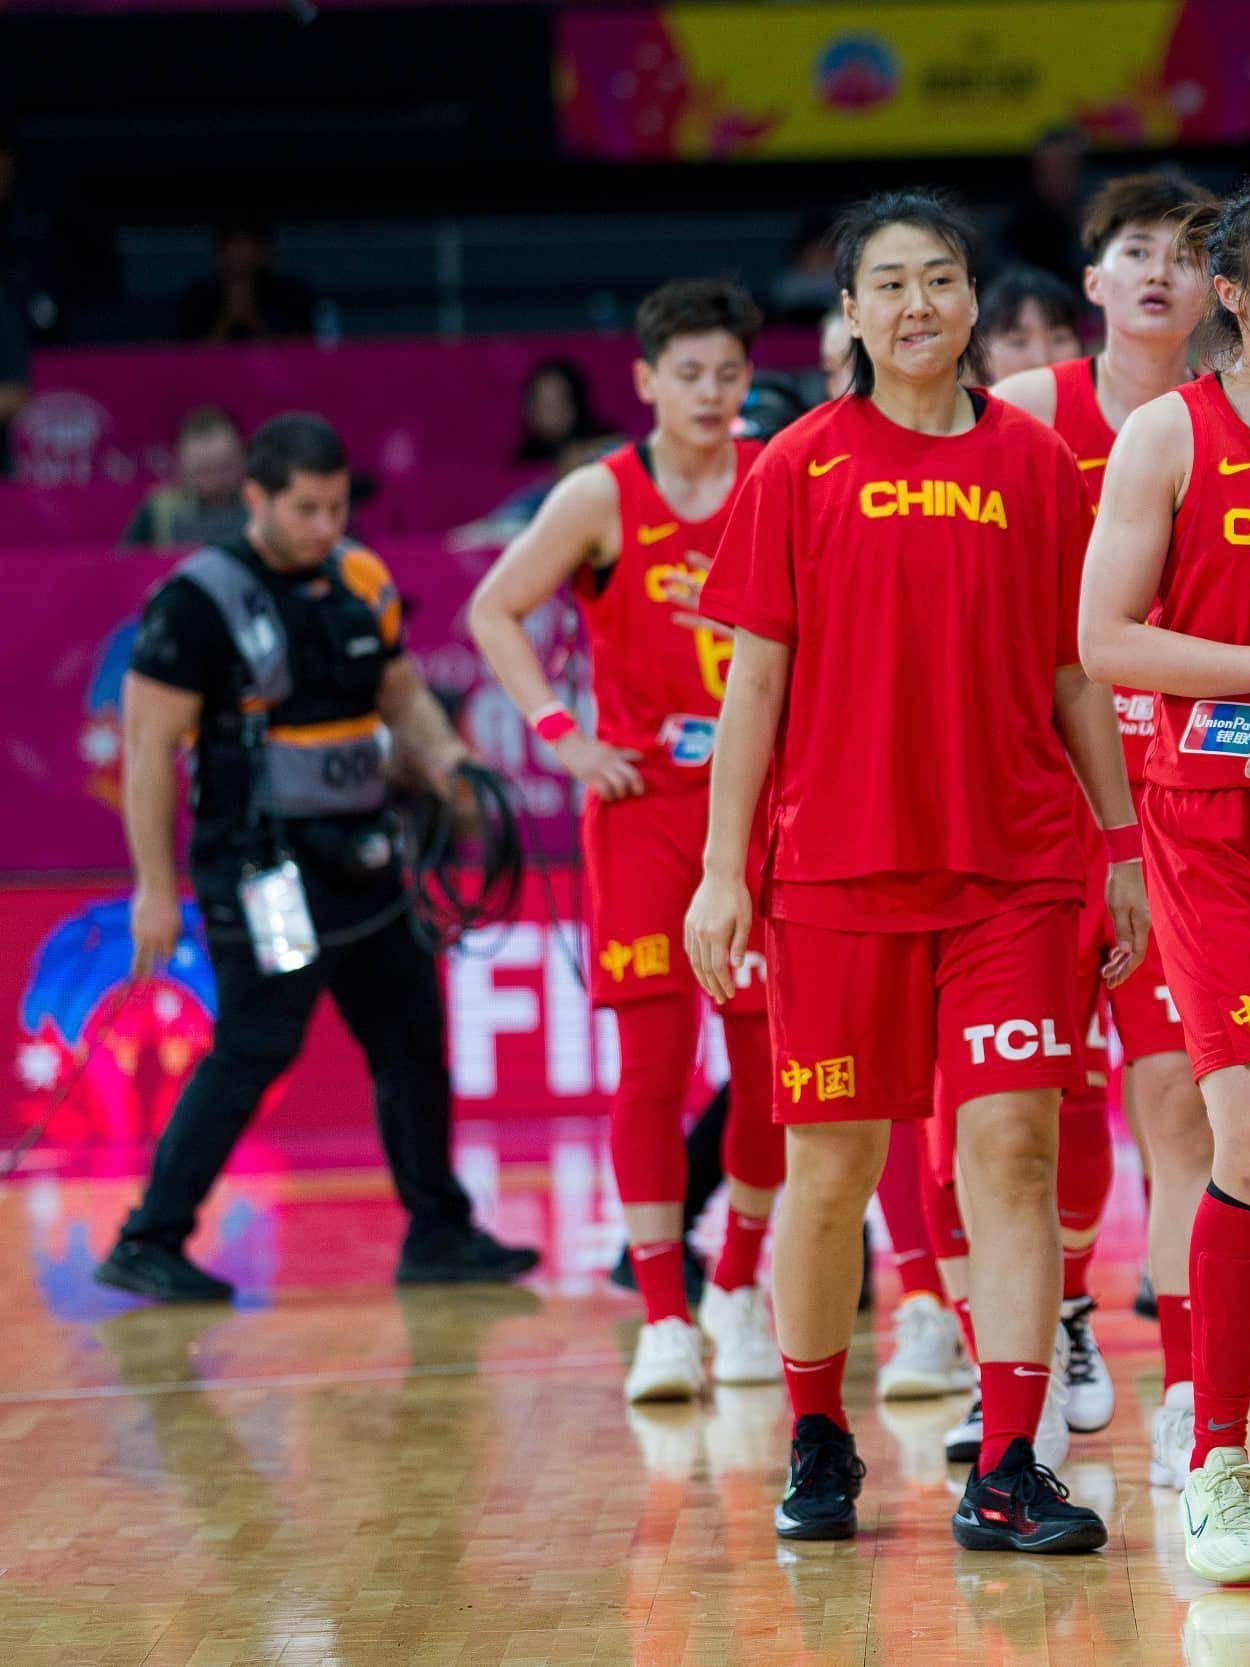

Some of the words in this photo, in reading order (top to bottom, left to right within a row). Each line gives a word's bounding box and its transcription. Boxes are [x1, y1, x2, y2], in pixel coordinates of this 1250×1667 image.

[859, 479, 1008, 530] CHINA
[1216, 729, 1250, 745] 银联
[600, 933, 670, 983] 中国
[450, 922, 620, 1097] FI
[963, 1018, 1071, 1065] TCL
[781, 1055, 855, 1103] 中国
